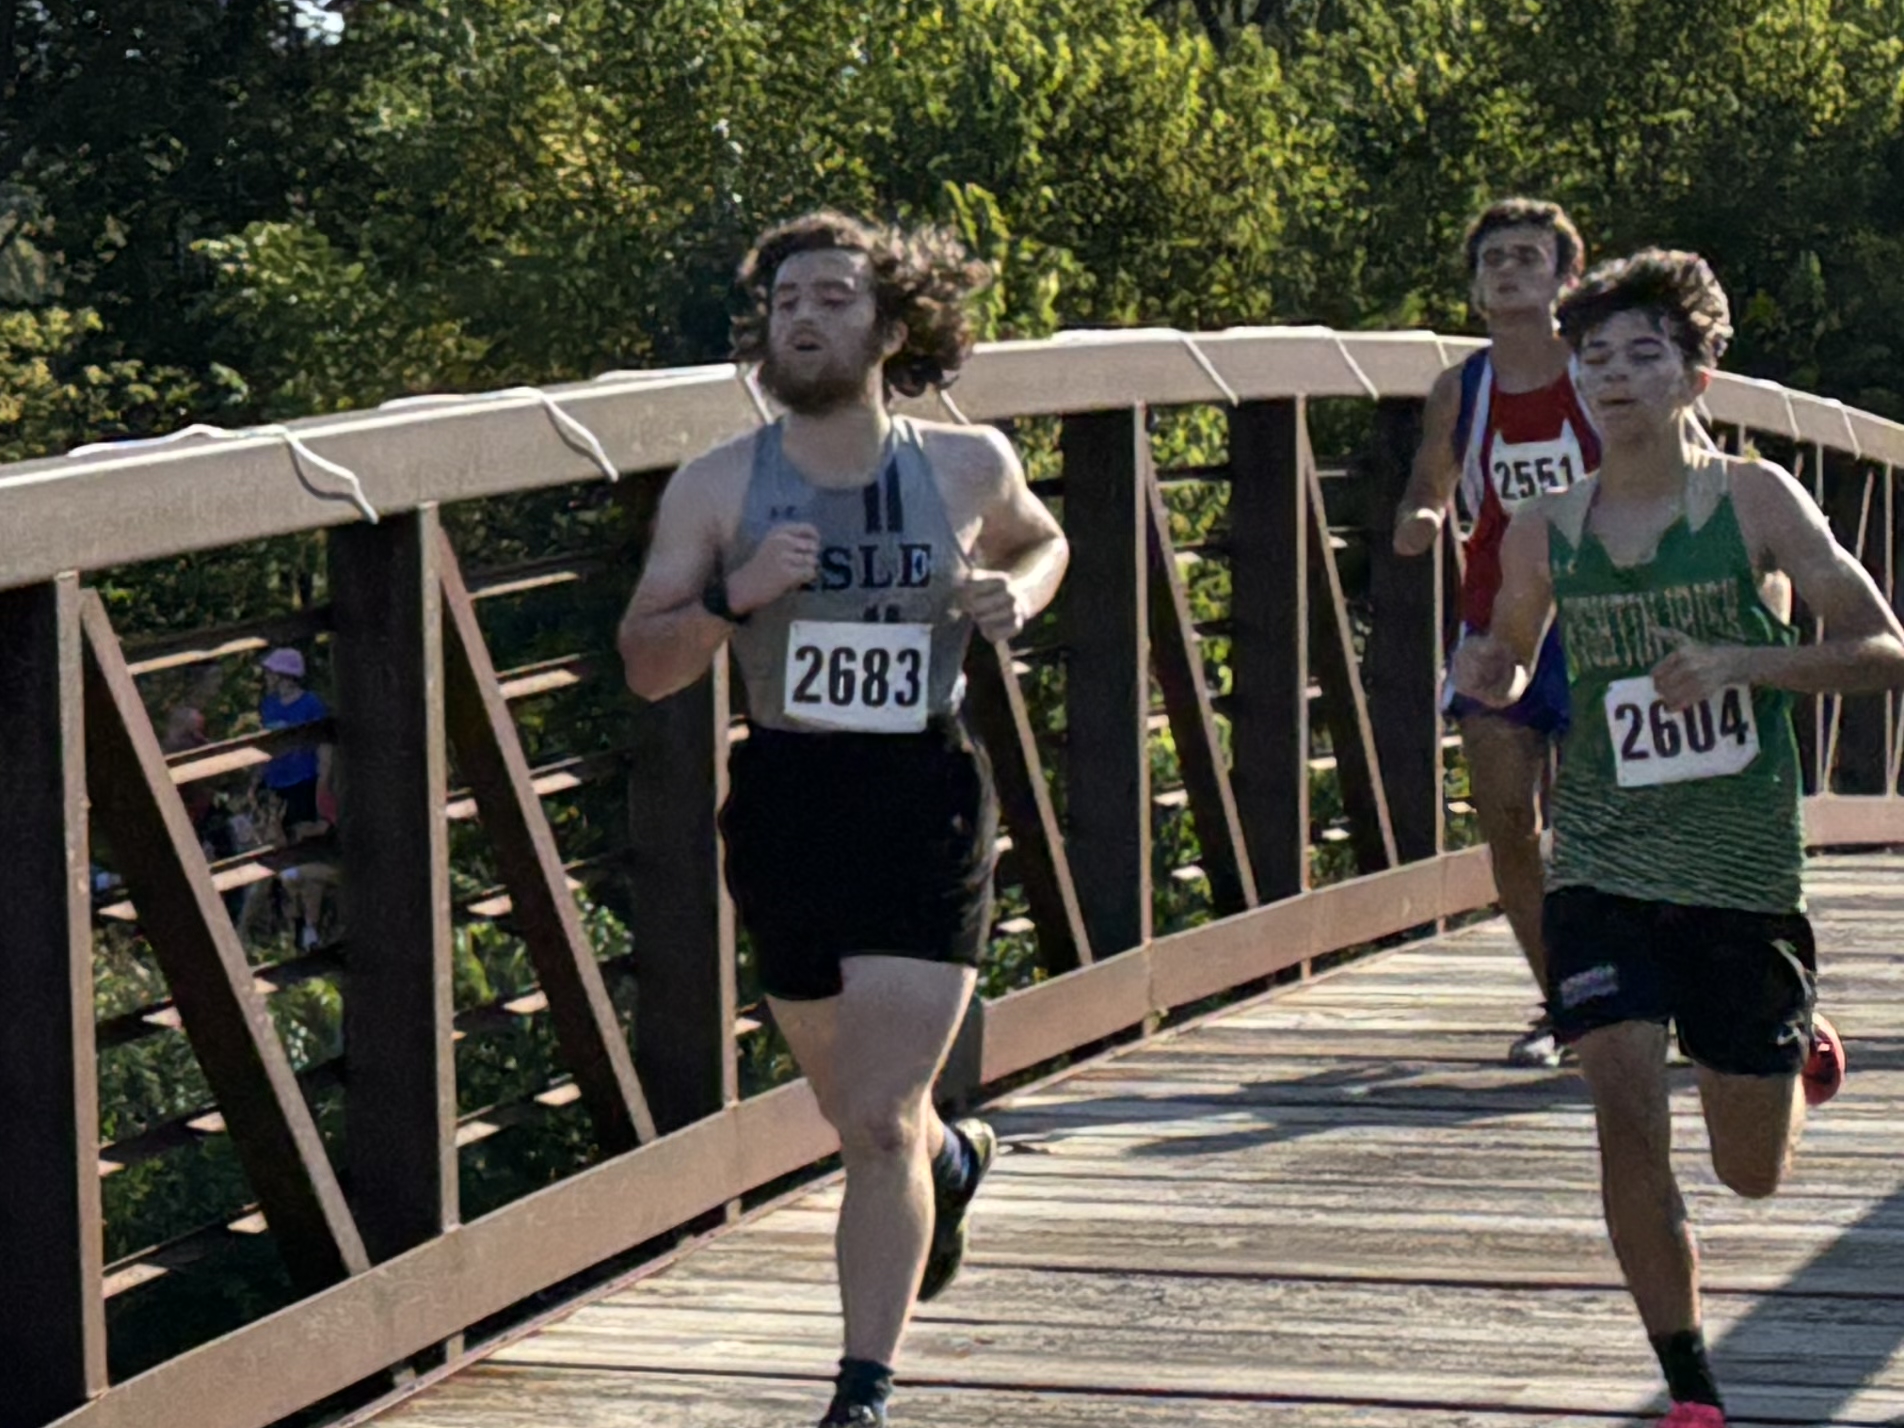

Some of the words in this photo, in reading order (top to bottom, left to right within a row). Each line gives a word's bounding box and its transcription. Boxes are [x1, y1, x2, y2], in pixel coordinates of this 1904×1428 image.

[1493, 455, 1574, 500] 2551
[799, 543, 933, 590] SLE
[792, 645, 922, 708] 2683
[1615, 687, 1749, 761] 2604
